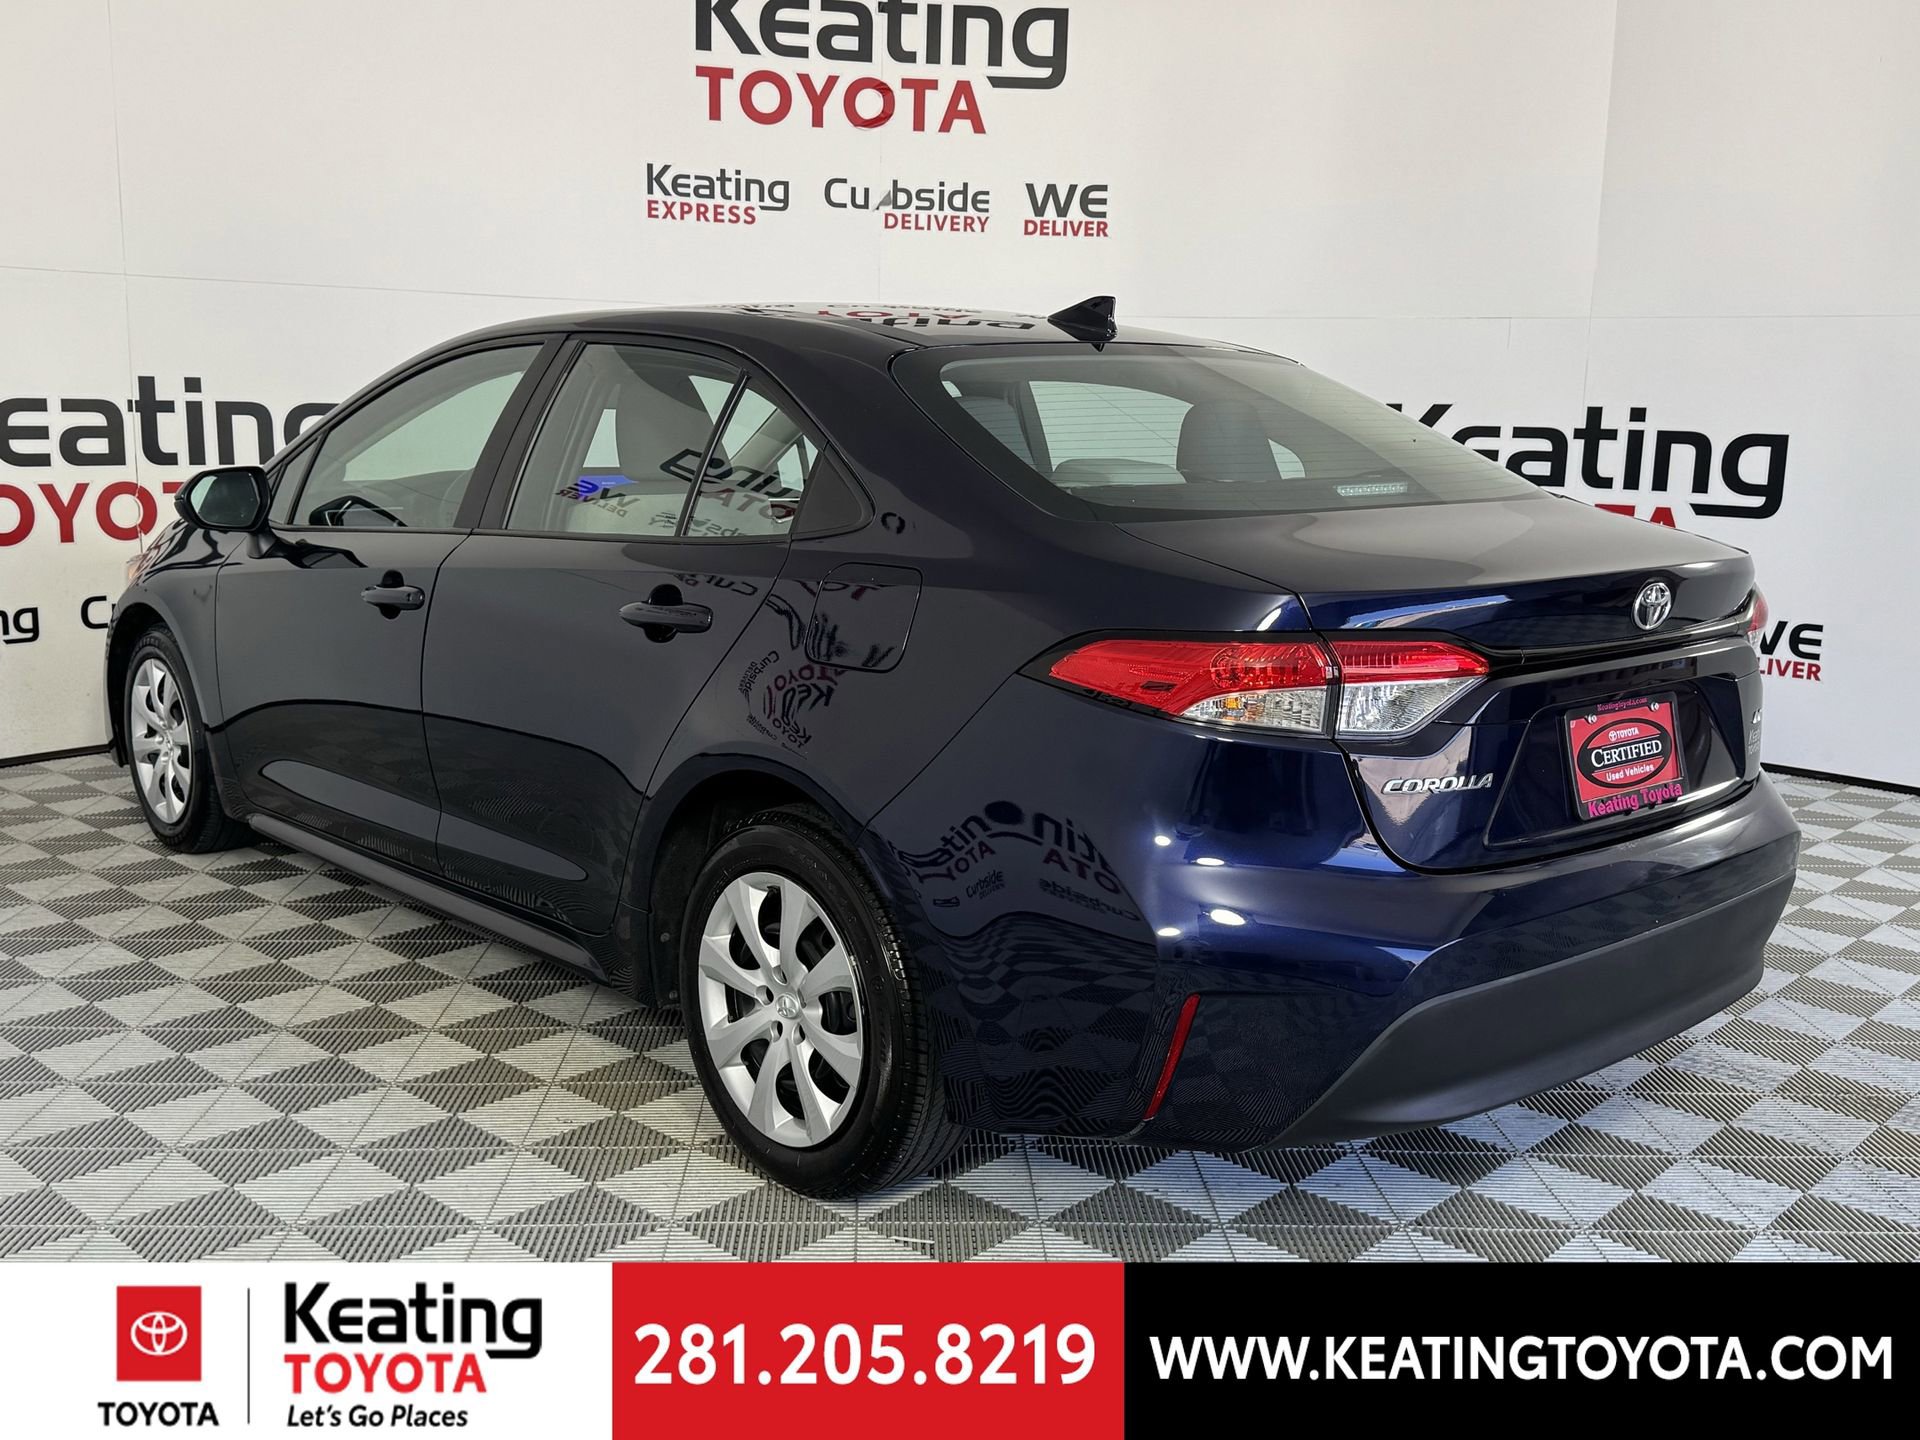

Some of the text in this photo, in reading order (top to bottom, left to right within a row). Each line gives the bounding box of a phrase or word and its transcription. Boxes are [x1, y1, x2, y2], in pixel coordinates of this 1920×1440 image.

[696, 0, 1069, 89] Keating
[695, 65, 987, 135] TOYOTA
[646, 162, 790, 212] Keating
[824, 177, 990, 213] Cubside
[1025, 183, 1109, 219] WE
[647, 200, 757, 225] EXPRESS
[884, 212, 990, 233] DELIVERY
[1023, 219, 1109, 237] DELIVER
[0, 481, 186, 547] OYO
[1617, 726, 1640, 739] TOYOTA
[1591, 740, 1662, 767] CERTIFIED
[1381, 773, 1494, 795] COROLLA
[1606, 763, 1655, 782] Used Vehicles
[1588, 783, 1683, 818] Keating Toyota
